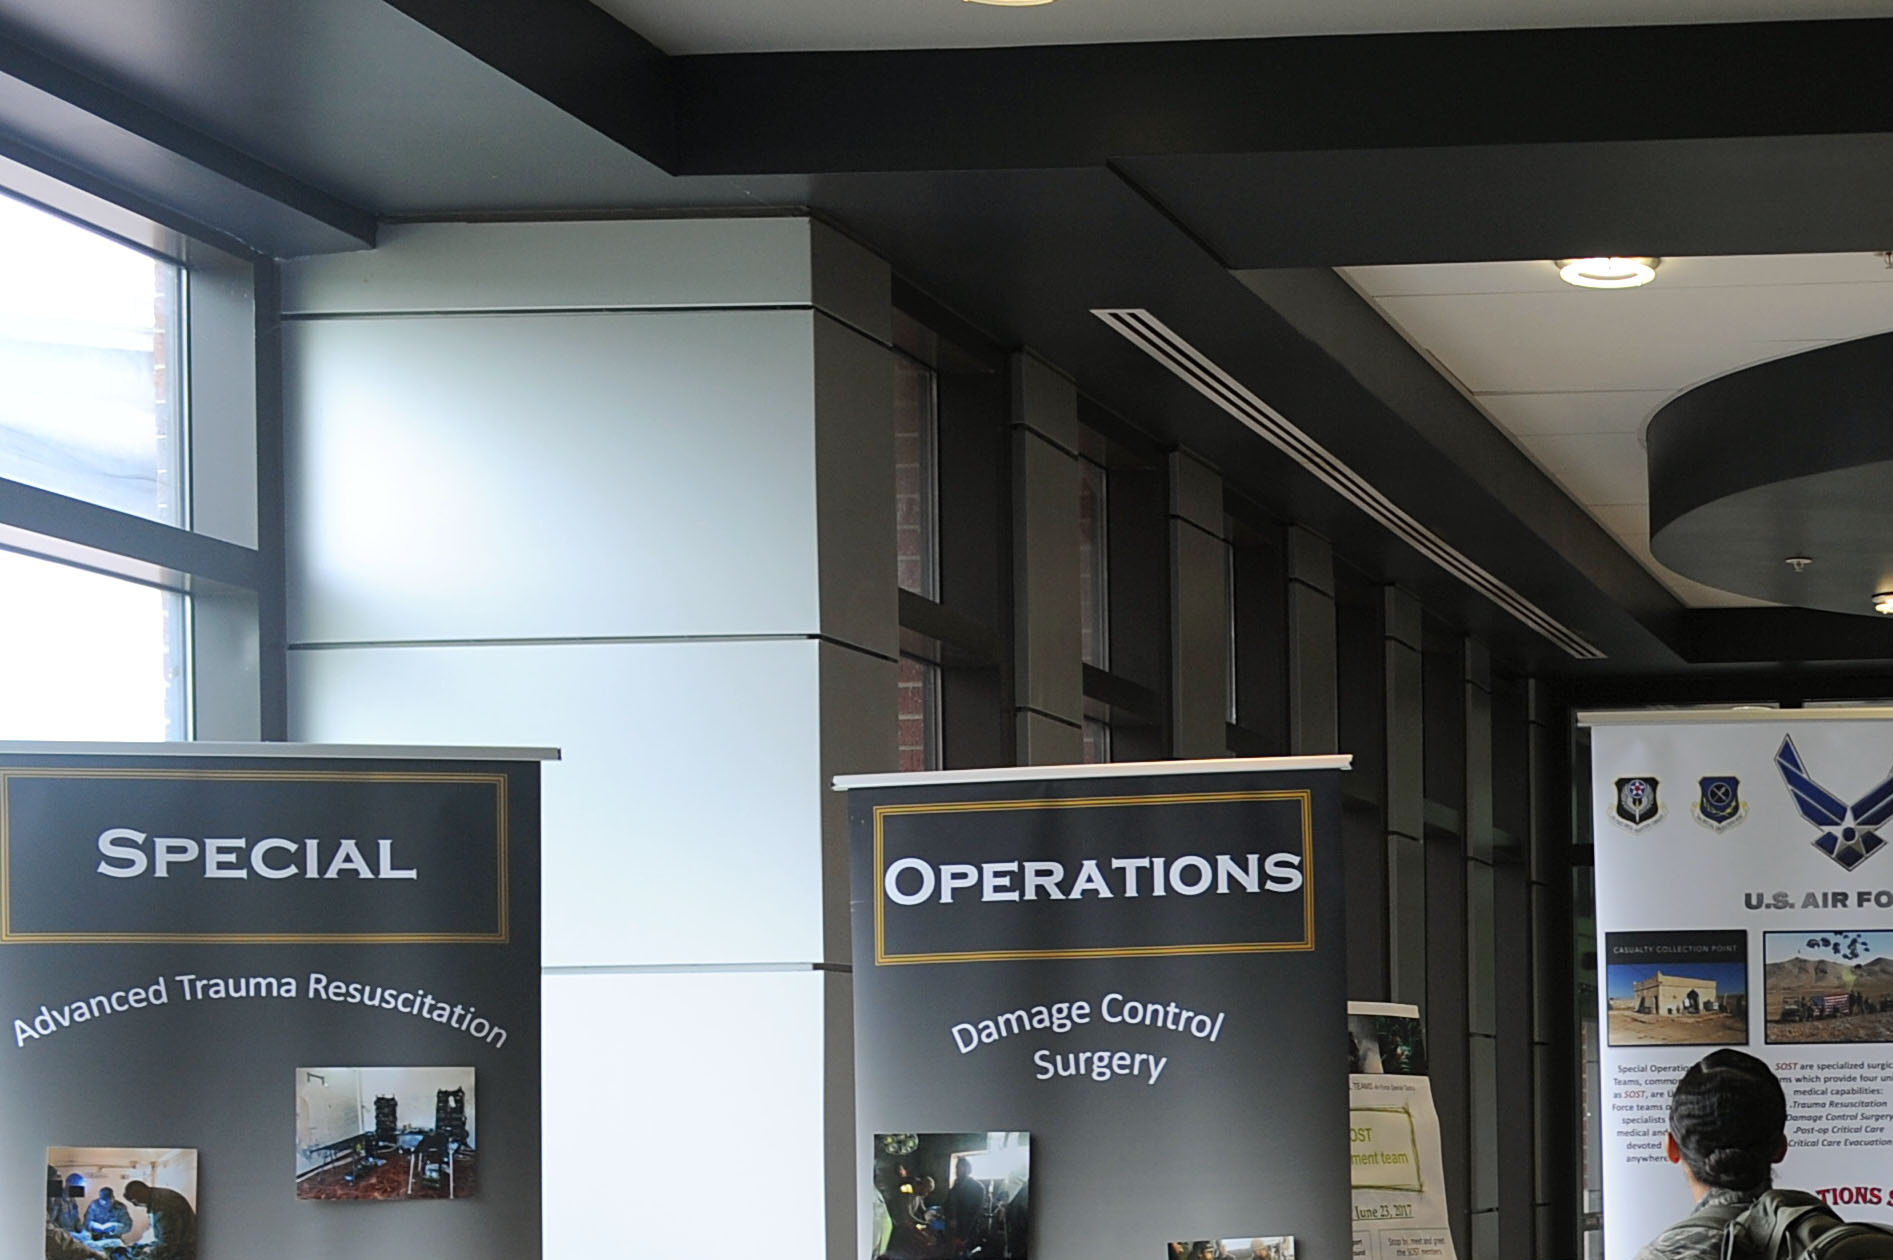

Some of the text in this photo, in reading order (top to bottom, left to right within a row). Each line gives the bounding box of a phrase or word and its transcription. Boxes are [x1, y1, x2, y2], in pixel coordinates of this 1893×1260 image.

[97, 829, 417, 879] SPECIAL
[883, 852, 1303, 905] OPERATIONS
[1744, 892, 1795, 911] U.S.
[1800, 891, 1850, 909] AIR
[1613, 944, 1738, 954] CASUALTY COLLECTION POINT
[12, 973, 508, 1049] Advanced Trauma Resuscitation
[950, 993, 1225, 1055] Damage Control
[1033, 1048, 1167, 1085] Surgery
[1618, 1064, 1648, 1074] Special
[1775, 1062, 1798, 1070] SOST
[1816, 1062, 1864, 1071] specialized
[1613, 1078, 1642, 1087] Teams,
[1824, 1074, 1857, 1084] provide
[1828, 1100, 1888, 1108] Resuscitation
[1622, 1116, 1666, 1125] specialists
[1826, 1113, 1858, 1121] Control
[1860, 1113, 1893, 1122] Surgery
[1350, 1128, 1372, 1142] OST
[1617, 1129, 1650, 1137] medical
[1832, 1126, 1862, 1134] Critical
[1864, 1126, 1884, 1134] Care
[1626, 1142, 1662, 1150] devoted
[1788, 1138, 1892, 1148] Critical Care Evacuation
[1381, 1152, 1408, 1164] team
[1816, 1187, 1882, 1206] TIONS
